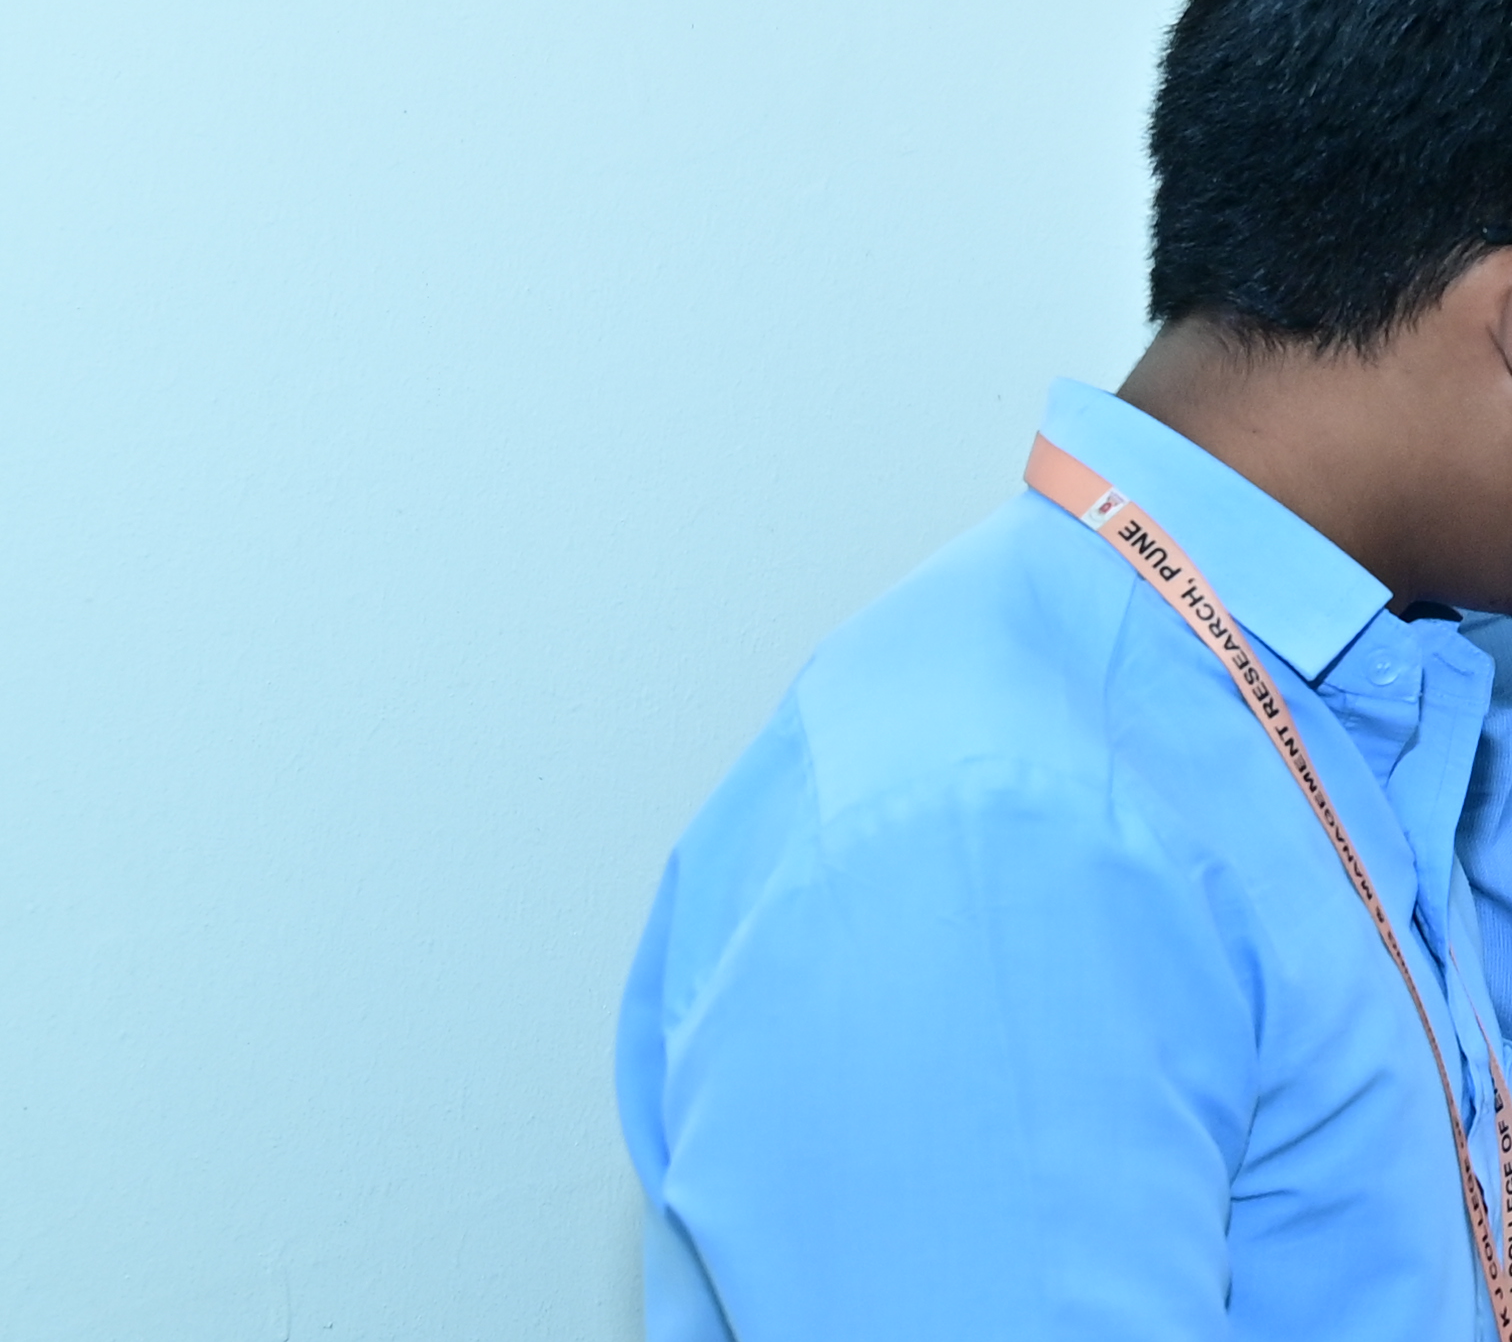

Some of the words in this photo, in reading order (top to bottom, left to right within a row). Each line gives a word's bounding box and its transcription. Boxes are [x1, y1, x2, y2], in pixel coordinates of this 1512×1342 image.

[1117, 519, 1182, 583] PUNE
[1181, 578, 1281, 720] RESEARCH,
[1274, 724, 1375, 902] MANAGEMENT
